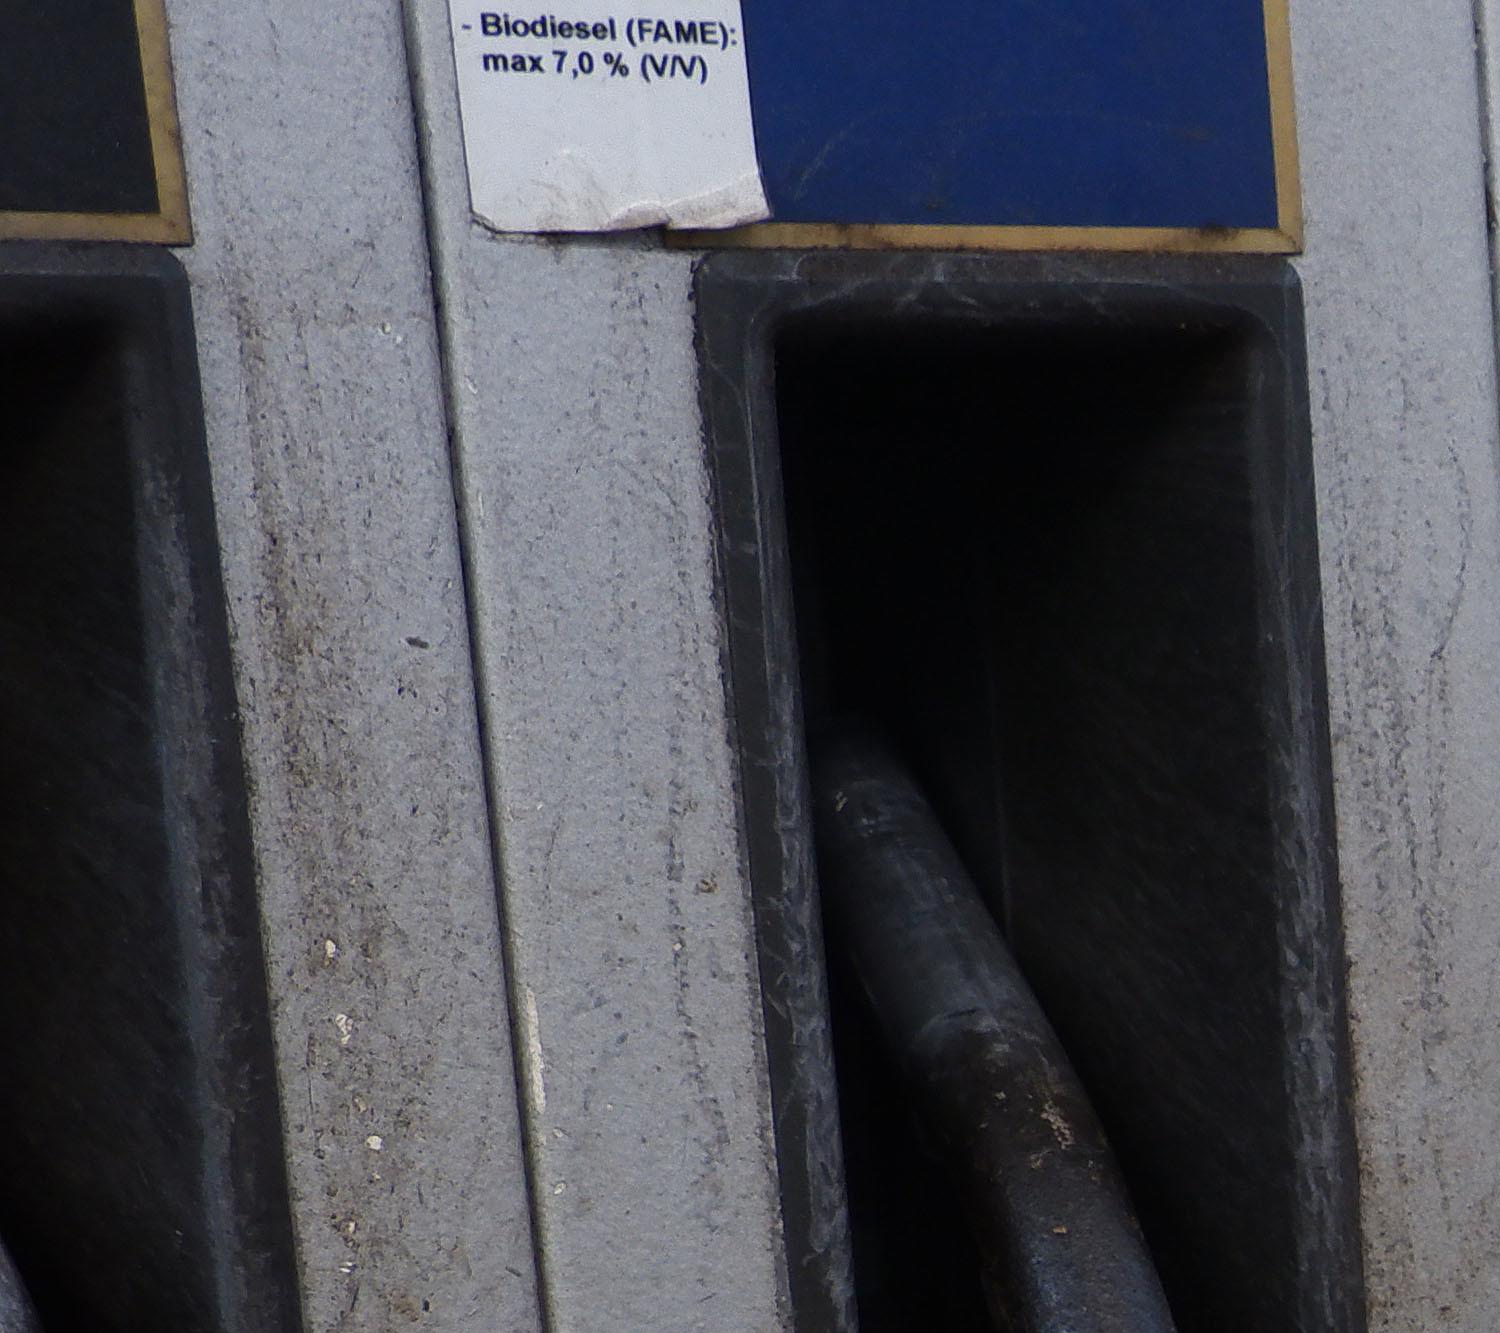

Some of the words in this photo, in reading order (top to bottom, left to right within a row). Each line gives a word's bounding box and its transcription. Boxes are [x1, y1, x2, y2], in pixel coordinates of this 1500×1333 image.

[480, 12, 616, 41] Biodiesel
[626, 18, 738, 50] (FAME):
[483, 52, 545, 75] max
[552, 50, 594, 79] 7,0
[603, 53, 630, 77] %
[640, 53, 708, 84] (V/V)
